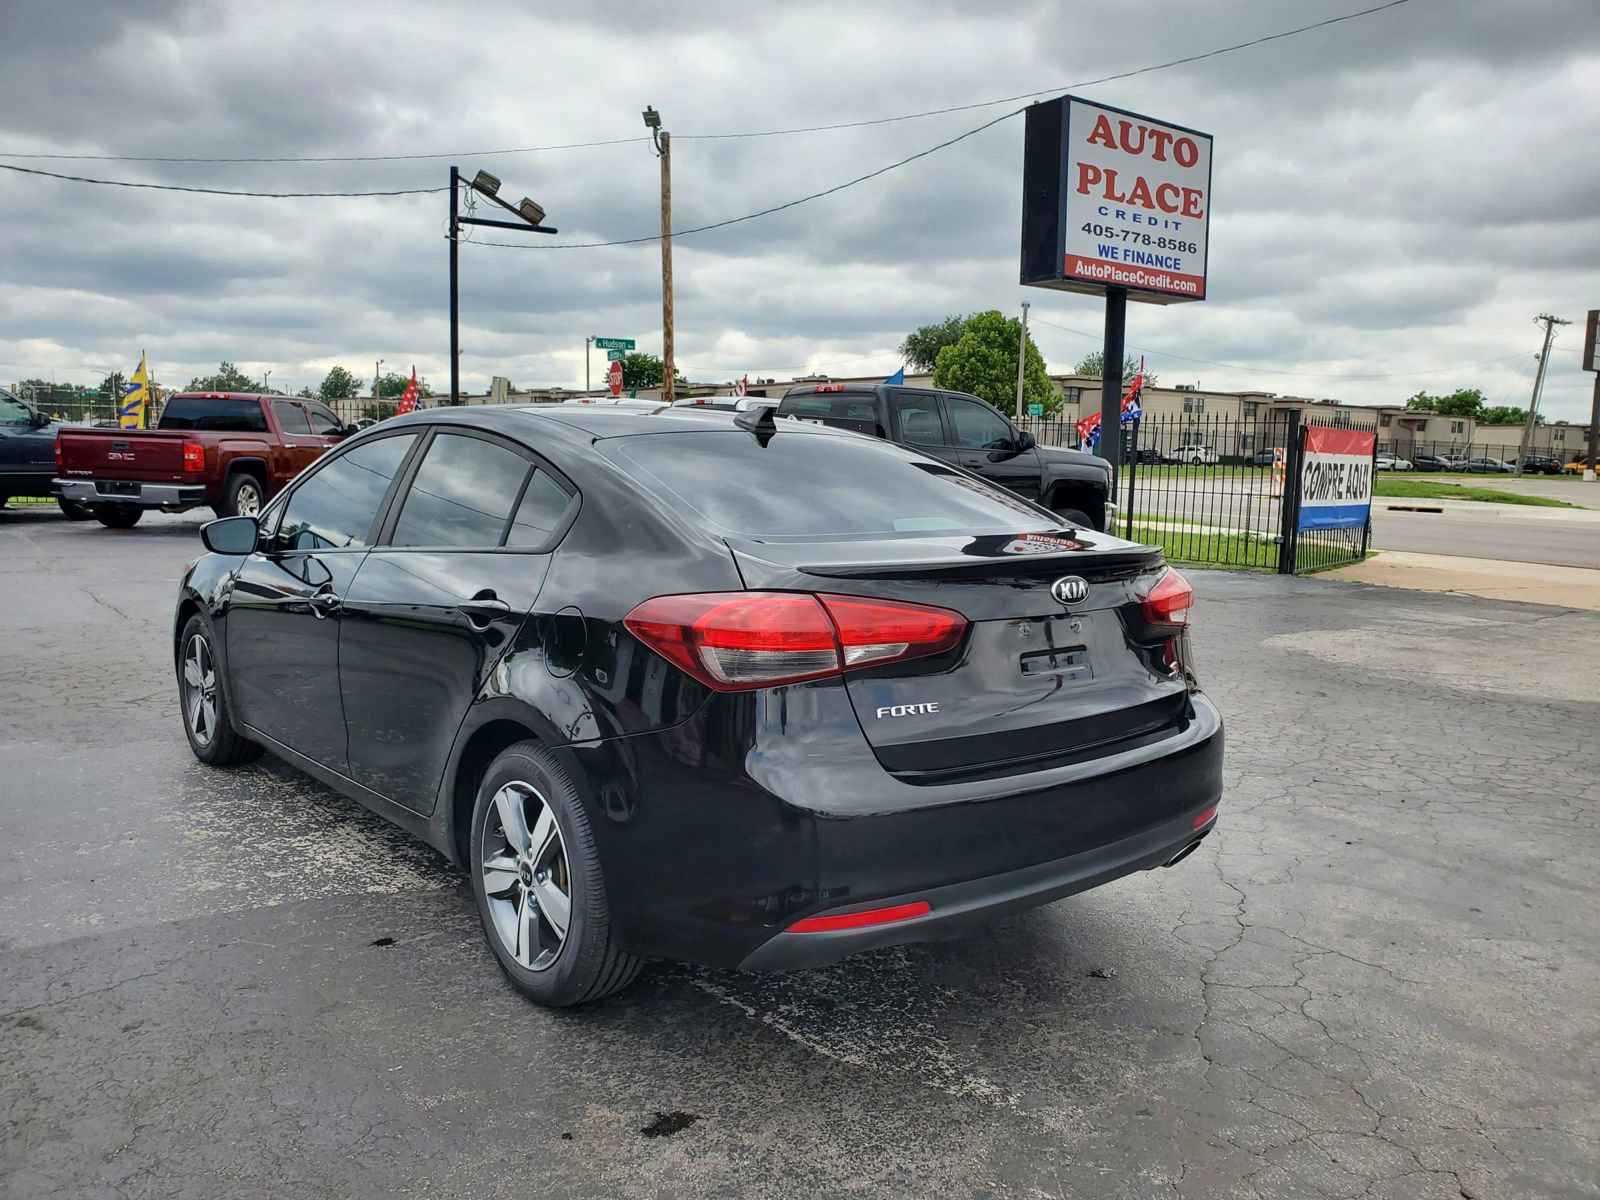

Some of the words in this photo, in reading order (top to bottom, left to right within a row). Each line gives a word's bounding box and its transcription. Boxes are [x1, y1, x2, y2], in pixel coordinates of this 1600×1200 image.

[1086, 114, 1199, 168] AUTO
[1076, 162, 1204, 219] PLACE
[1098, 206, 1182, 231] CREDIT
[1081, 222, 1197, 254] 405-778-8586
[1097, 243, 1119, 260] WE
[1123, 249, 1181, 270] FINANCE
[1075, 260, 1197, 292] AutoPlaceCredit.com
[610, 371, 622, 386] STOP
[1303, 461, 1345, 500] COMPRE
[1345, 463, 1369, 500] AQUI
[1060, 581, 1087, 600] KIA
[877, 702, 940, 719] FORTE
